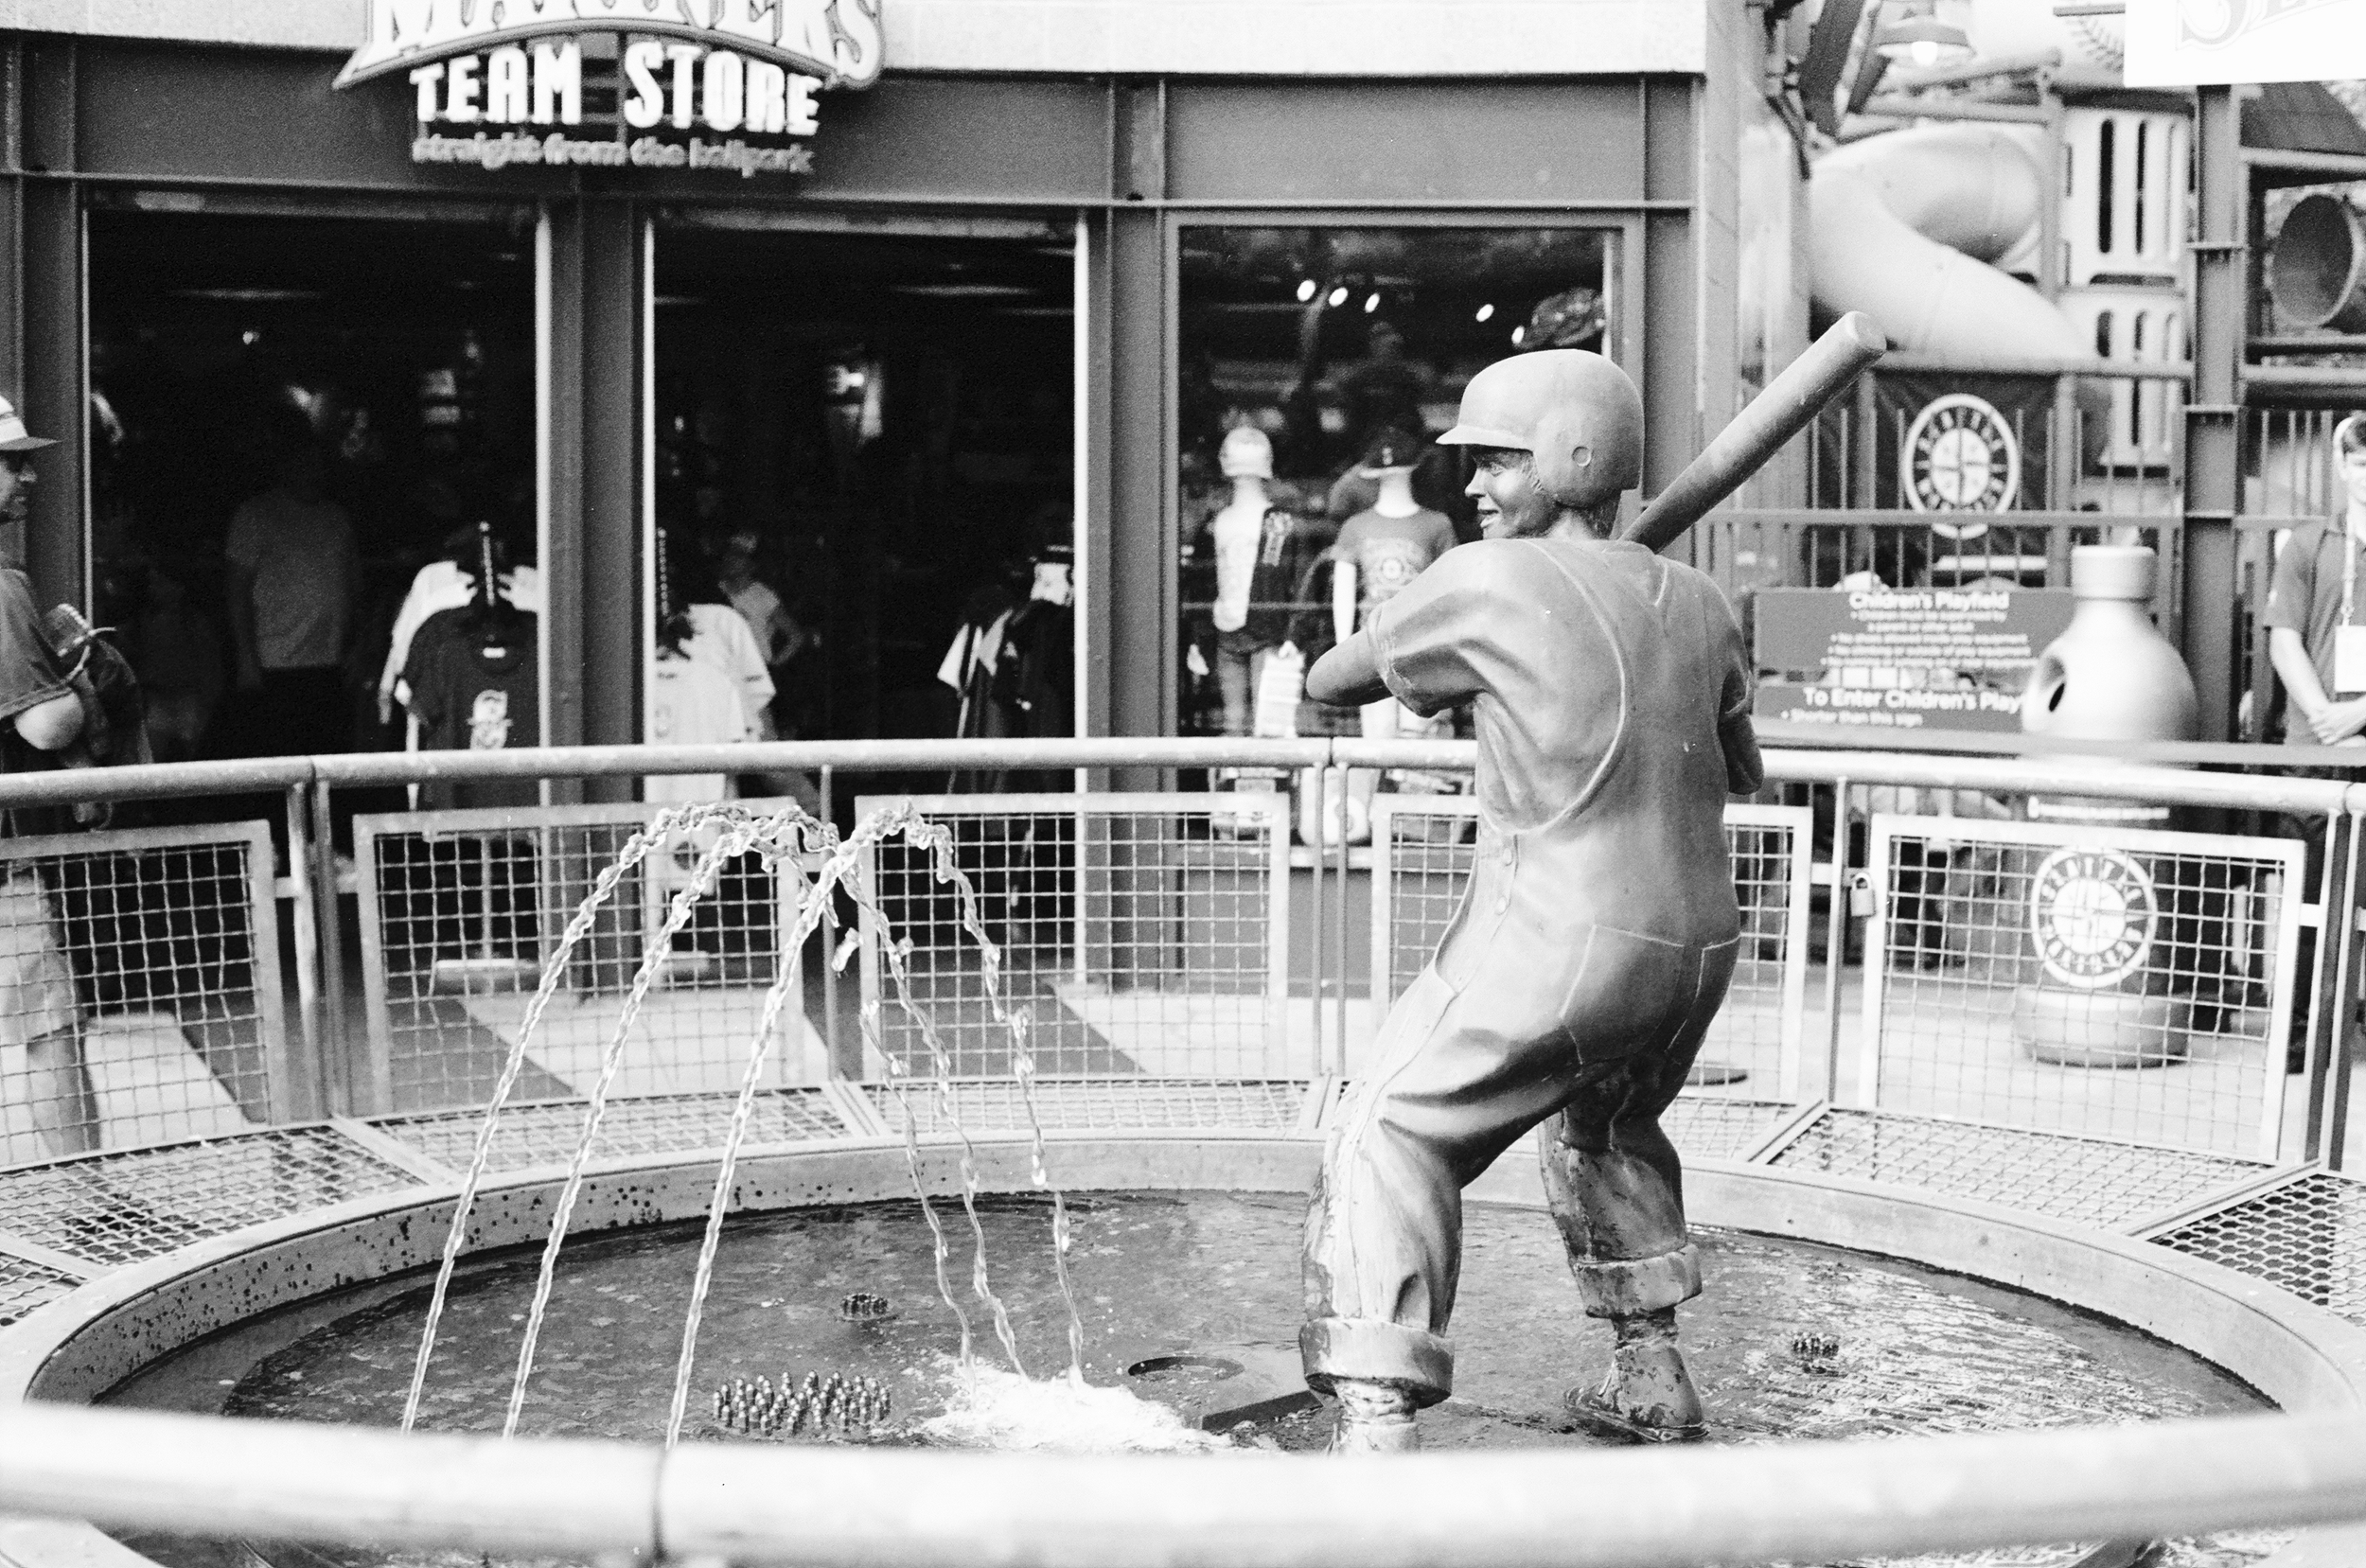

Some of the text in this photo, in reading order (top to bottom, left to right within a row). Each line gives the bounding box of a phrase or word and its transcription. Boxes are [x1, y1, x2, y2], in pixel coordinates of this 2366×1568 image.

[410, 41, 825, 136] TEAM STORE
[412, 132, 541, 170] straight
[542, 132, 628, 166] from
[1848, 590, 2010, 612] Children's Playfield
[1803, 687, 2024, 715] To Enter Children's Play
